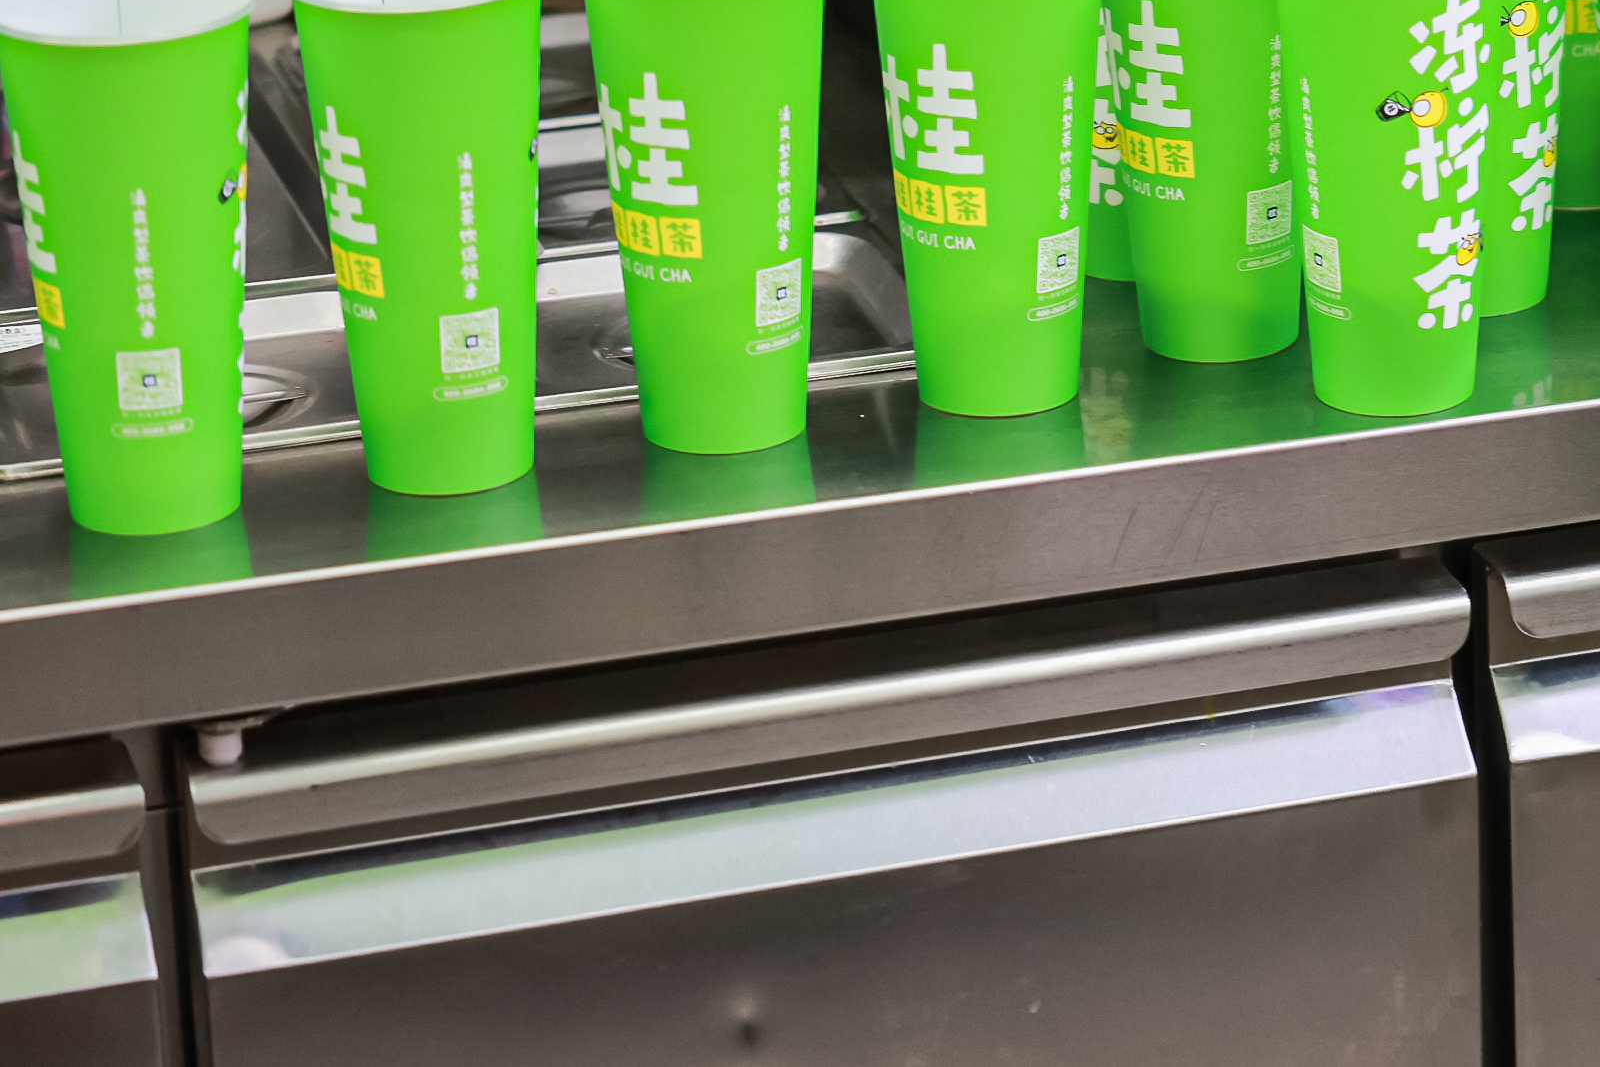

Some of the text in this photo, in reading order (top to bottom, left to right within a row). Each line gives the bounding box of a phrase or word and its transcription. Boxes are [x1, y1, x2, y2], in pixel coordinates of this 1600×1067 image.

[882, 42, 985, 175] 桂
[599, 72, 699, 206] 桂
[1155, 185, 1186, 202] CHA
[917, 229, 940, 248] GUI
[943, 235, 977, 251] CHA
[660, 266, 692, 282] CHA
